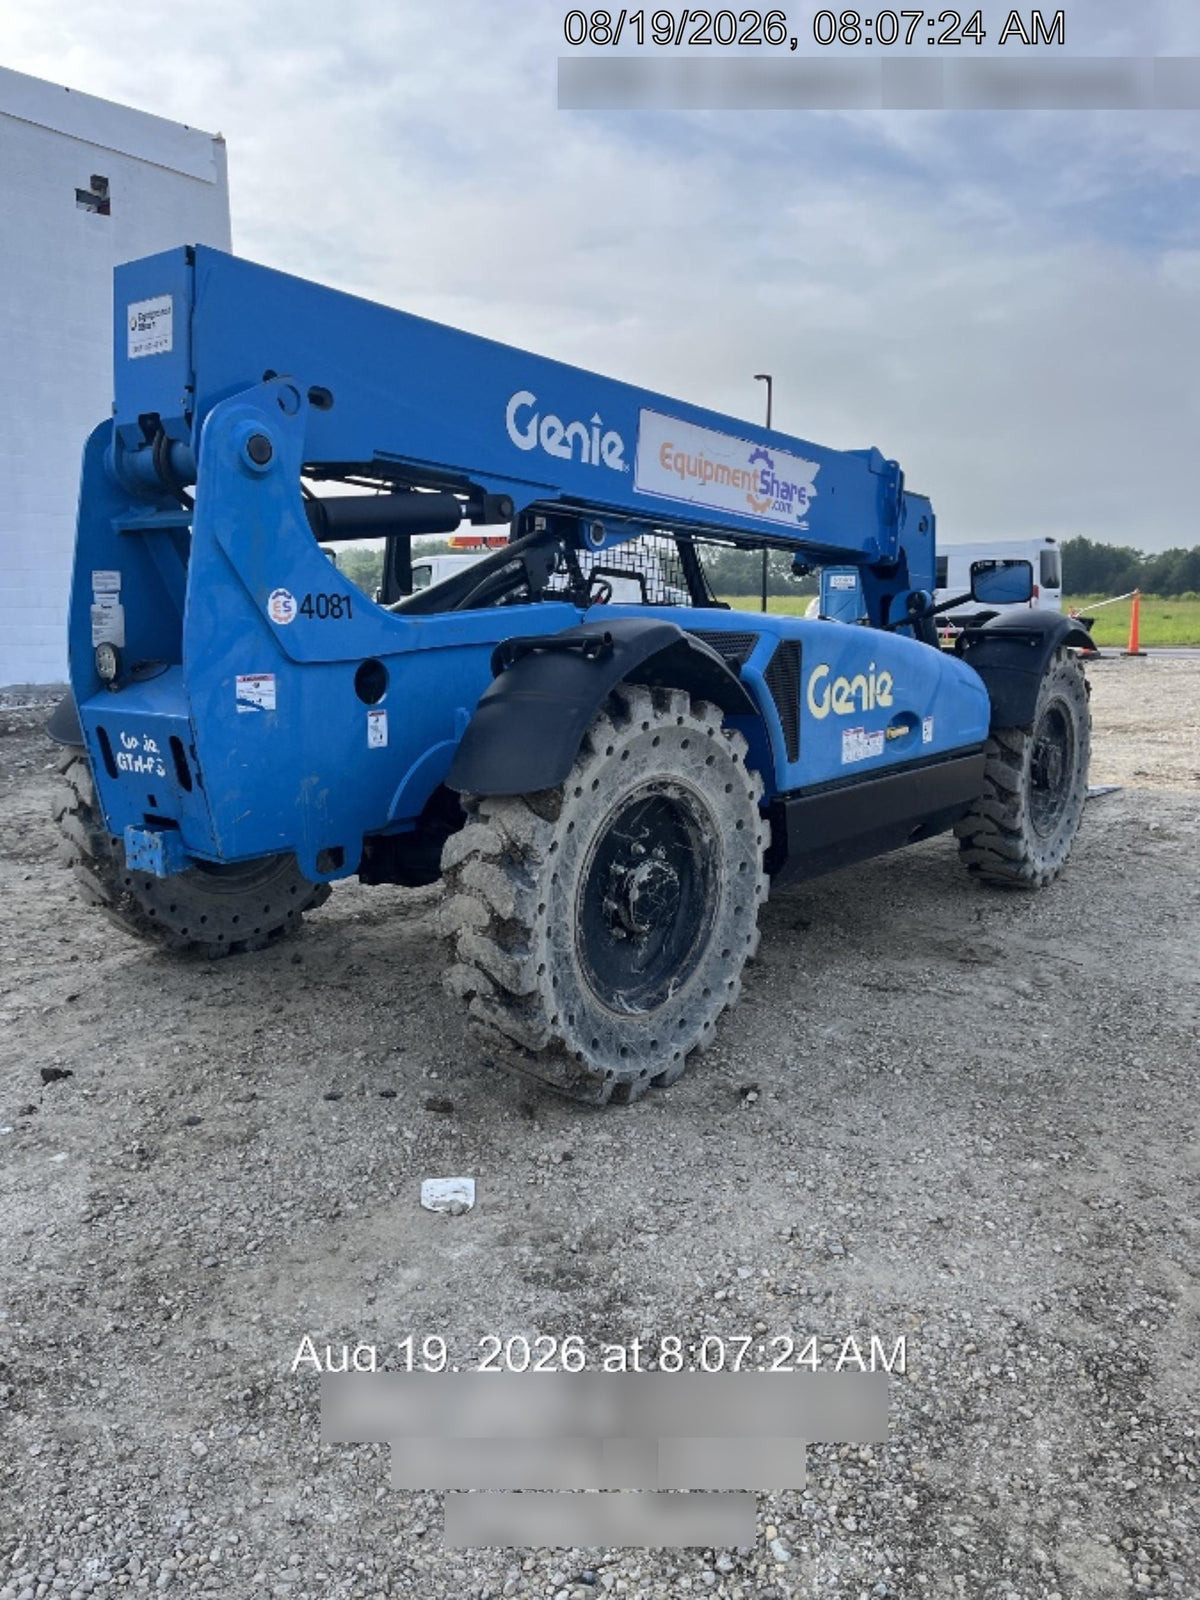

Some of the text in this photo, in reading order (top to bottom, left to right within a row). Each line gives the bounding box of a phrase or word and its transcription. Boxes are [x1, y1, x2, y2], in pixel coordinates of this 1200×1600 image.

[505, 390, 625, 472] Genie
[300, 593, 353, 619] 4081
[807, 661, 893, 720] Genie
